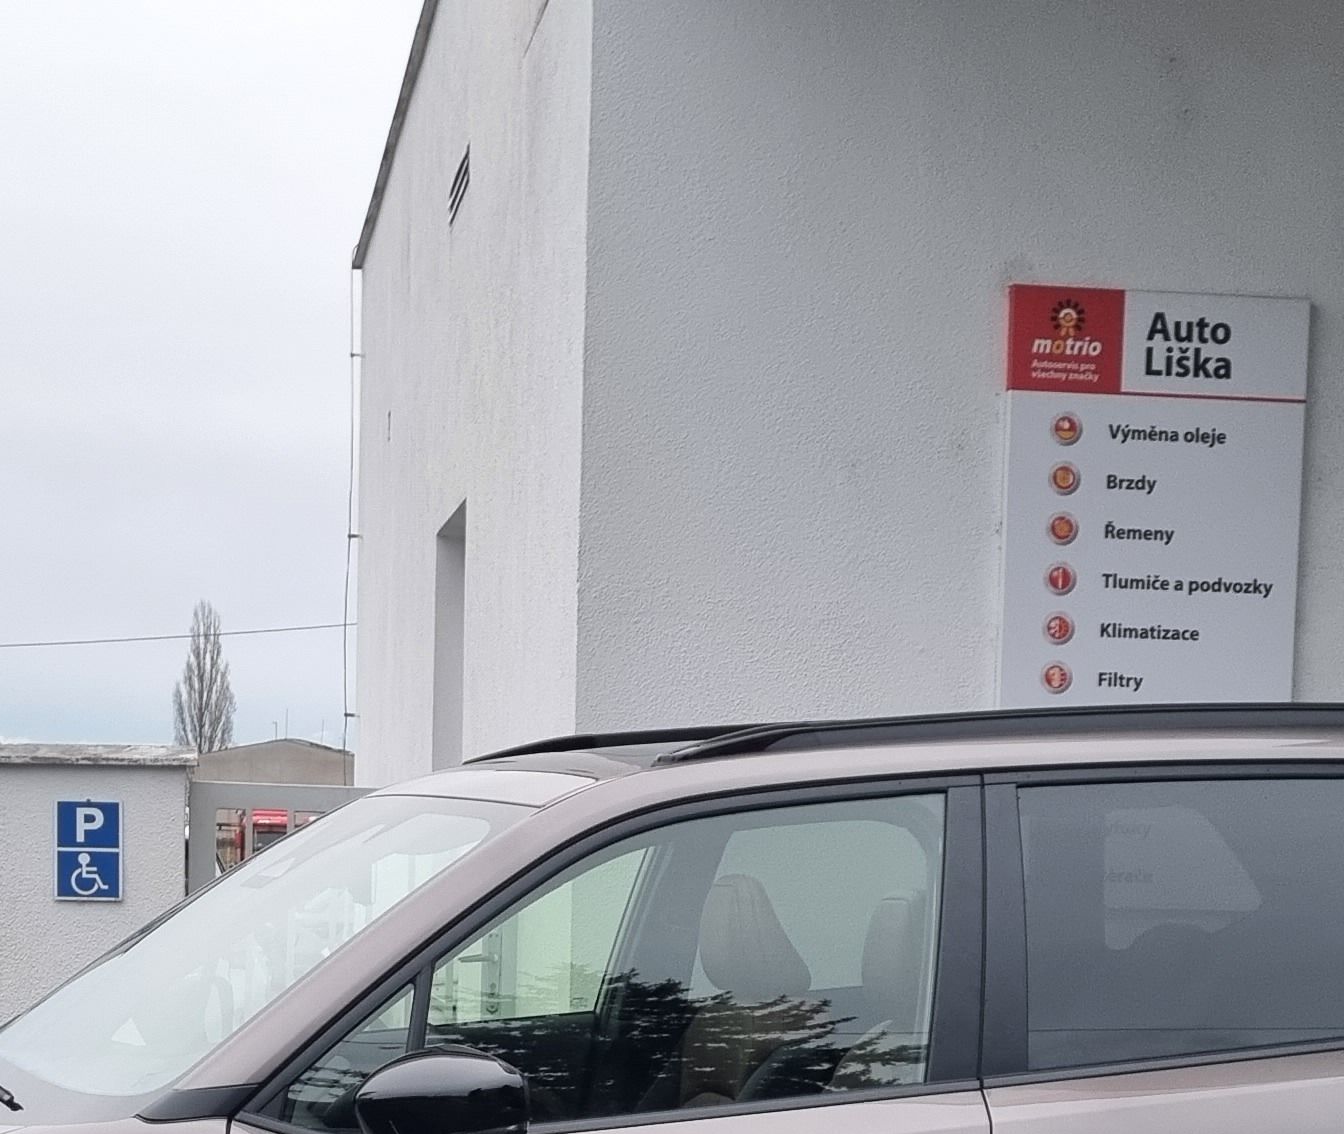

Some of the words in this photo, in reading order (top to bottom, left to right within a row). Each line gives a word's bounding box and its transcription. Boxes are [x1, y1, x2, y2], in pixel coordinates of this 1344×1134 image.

[1146, 312, 1233, 345] Auto
[1032, 336, 1102, 356] motrio
[1144, 346, 1233, 380] Liška
[1108, 423, 1179, 443] Výměna
[1182, 427, 1227, 448] oleje
[1106, 474, 1157, 495] Brzdy
[1104, 521, 1175, 544] Řemeny
[1102, 573, 1170, 592] Tlumiče
[1173, 580, 1184, 592] a
[1188, 576, 1274, 599] podvozky
[1099, 623, 1200, 642] Klimatizace
[1097, 672, 1144, 693] Filtry
[76, 807, 105, 843] P
